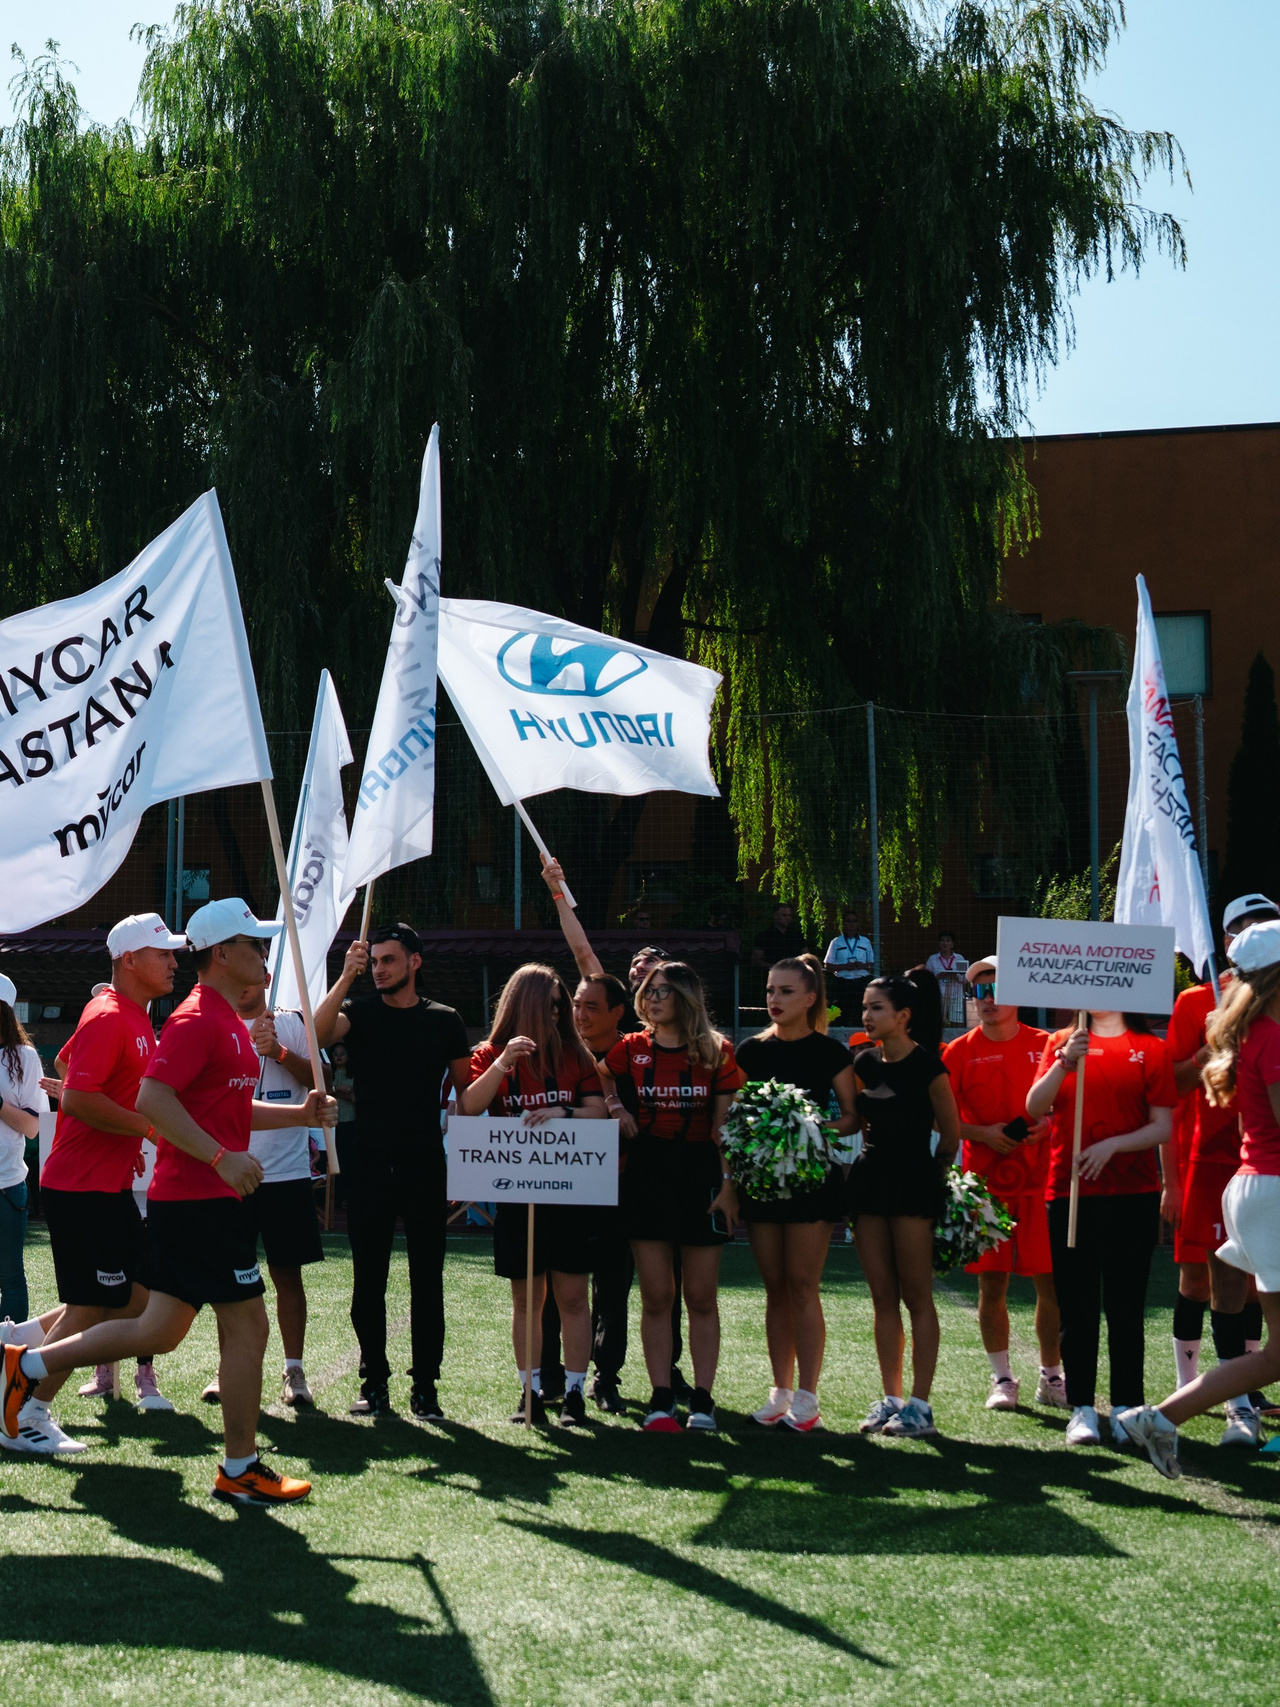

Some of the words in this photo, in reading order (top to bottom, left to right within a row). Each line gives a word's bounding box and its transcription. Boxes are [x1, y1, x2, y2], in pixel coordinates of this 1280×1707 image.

[508, 709, 673, 748] HYUNDAI
[1019, 942, 1082, 956] ASTANA
[1086, 945, 1156, 960] MOTORS
[1017, 956, 1152, 975] MANUFACTURING
[1028, 971, 1134, 988] KAZAKHSTAN
[136, 1035, 149, 1057] 99
[503, 1090, 573, 1108] HYUNDAI
[637, 1086, 707, 1097] HYUNDAI
[489, 1130, 575, 1145] HYUNDAI
[459, 1149, 522, 1164] TRANS
[528, 1151, 607, 1166] ALMATY
[517, 1180, 573, 1190] HYUNDAI
[239, 1268, 259, 1281] myca
